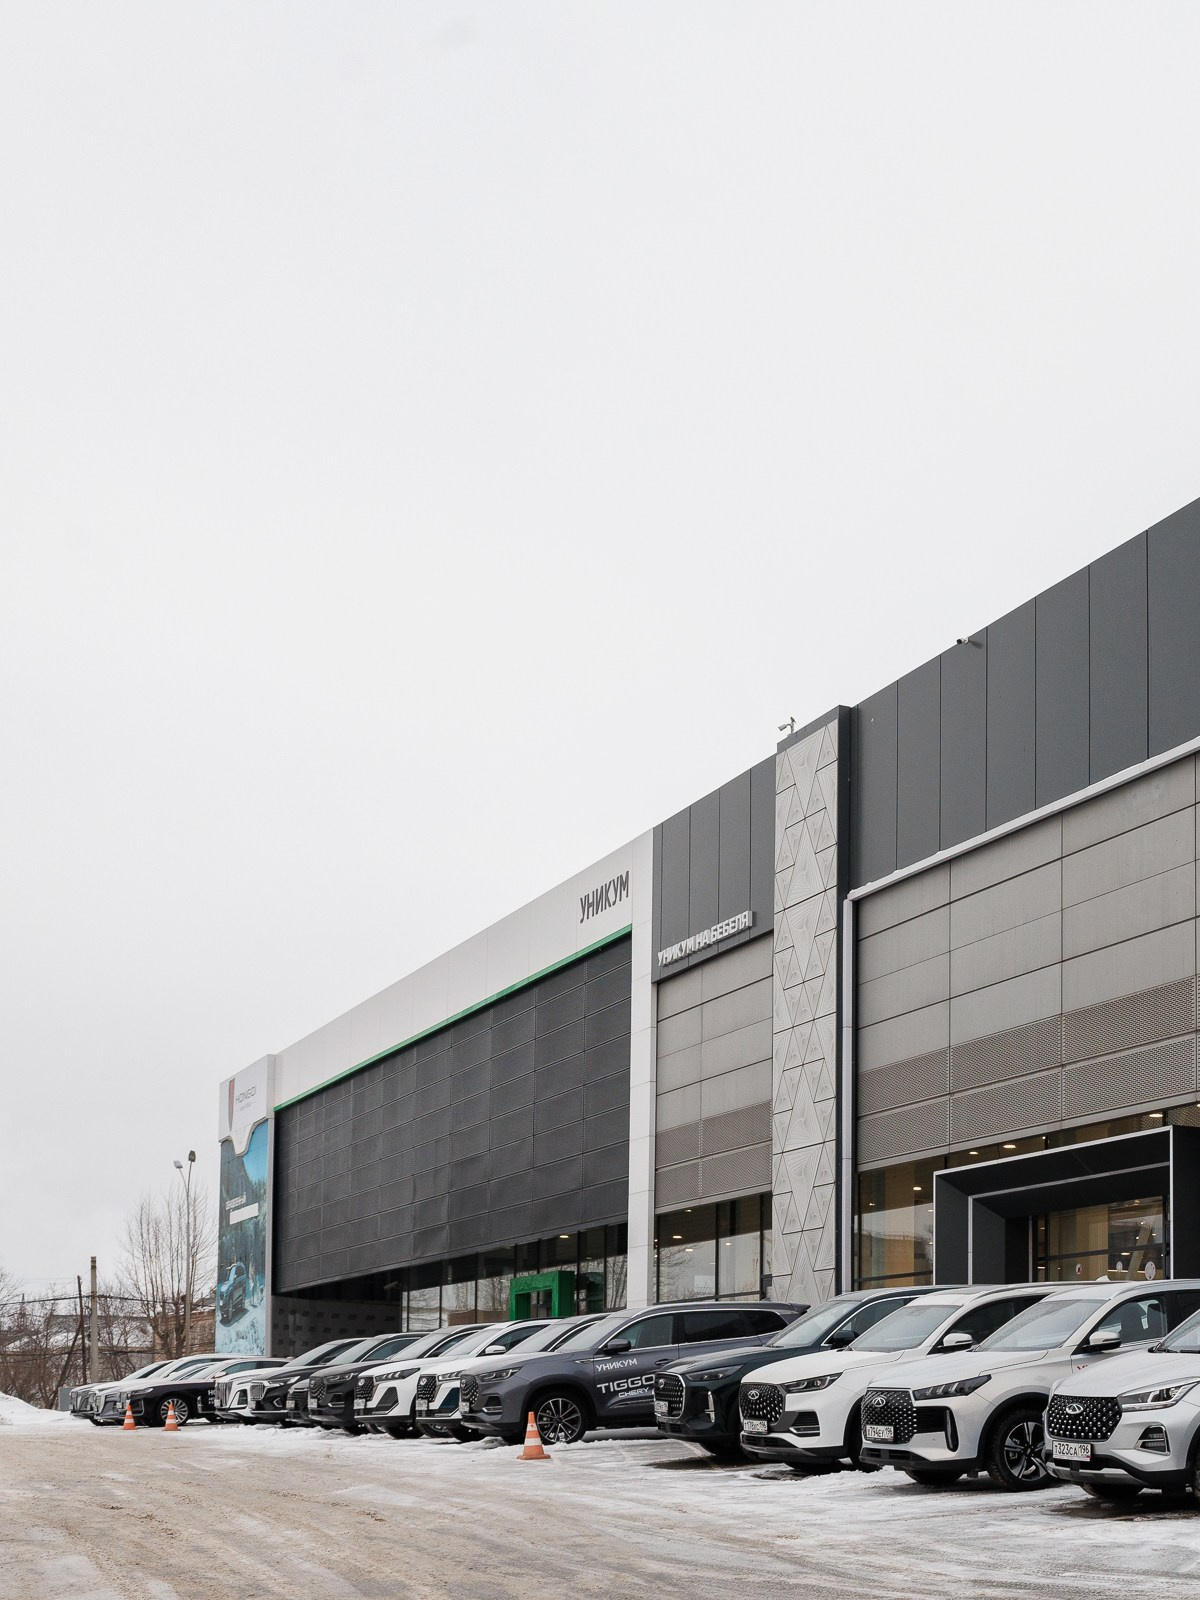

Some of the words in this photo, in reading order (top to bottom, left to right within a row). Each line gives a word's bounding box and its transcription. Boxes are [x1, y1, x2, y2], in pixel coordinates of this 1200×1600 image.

[579, 870, 630, 924] УНИКУМ
[657, 935, 697, 967] УНИКУМ
[696, 928, 711, 950] НА
[710, 910, 753, 943] БЕБЕЛЯ
[595, 1358, 638, 1372] УНИКУМ
[596, 1373, 656, 1394] TIGGO
[618, 1386, 650, 1398] CHERY
